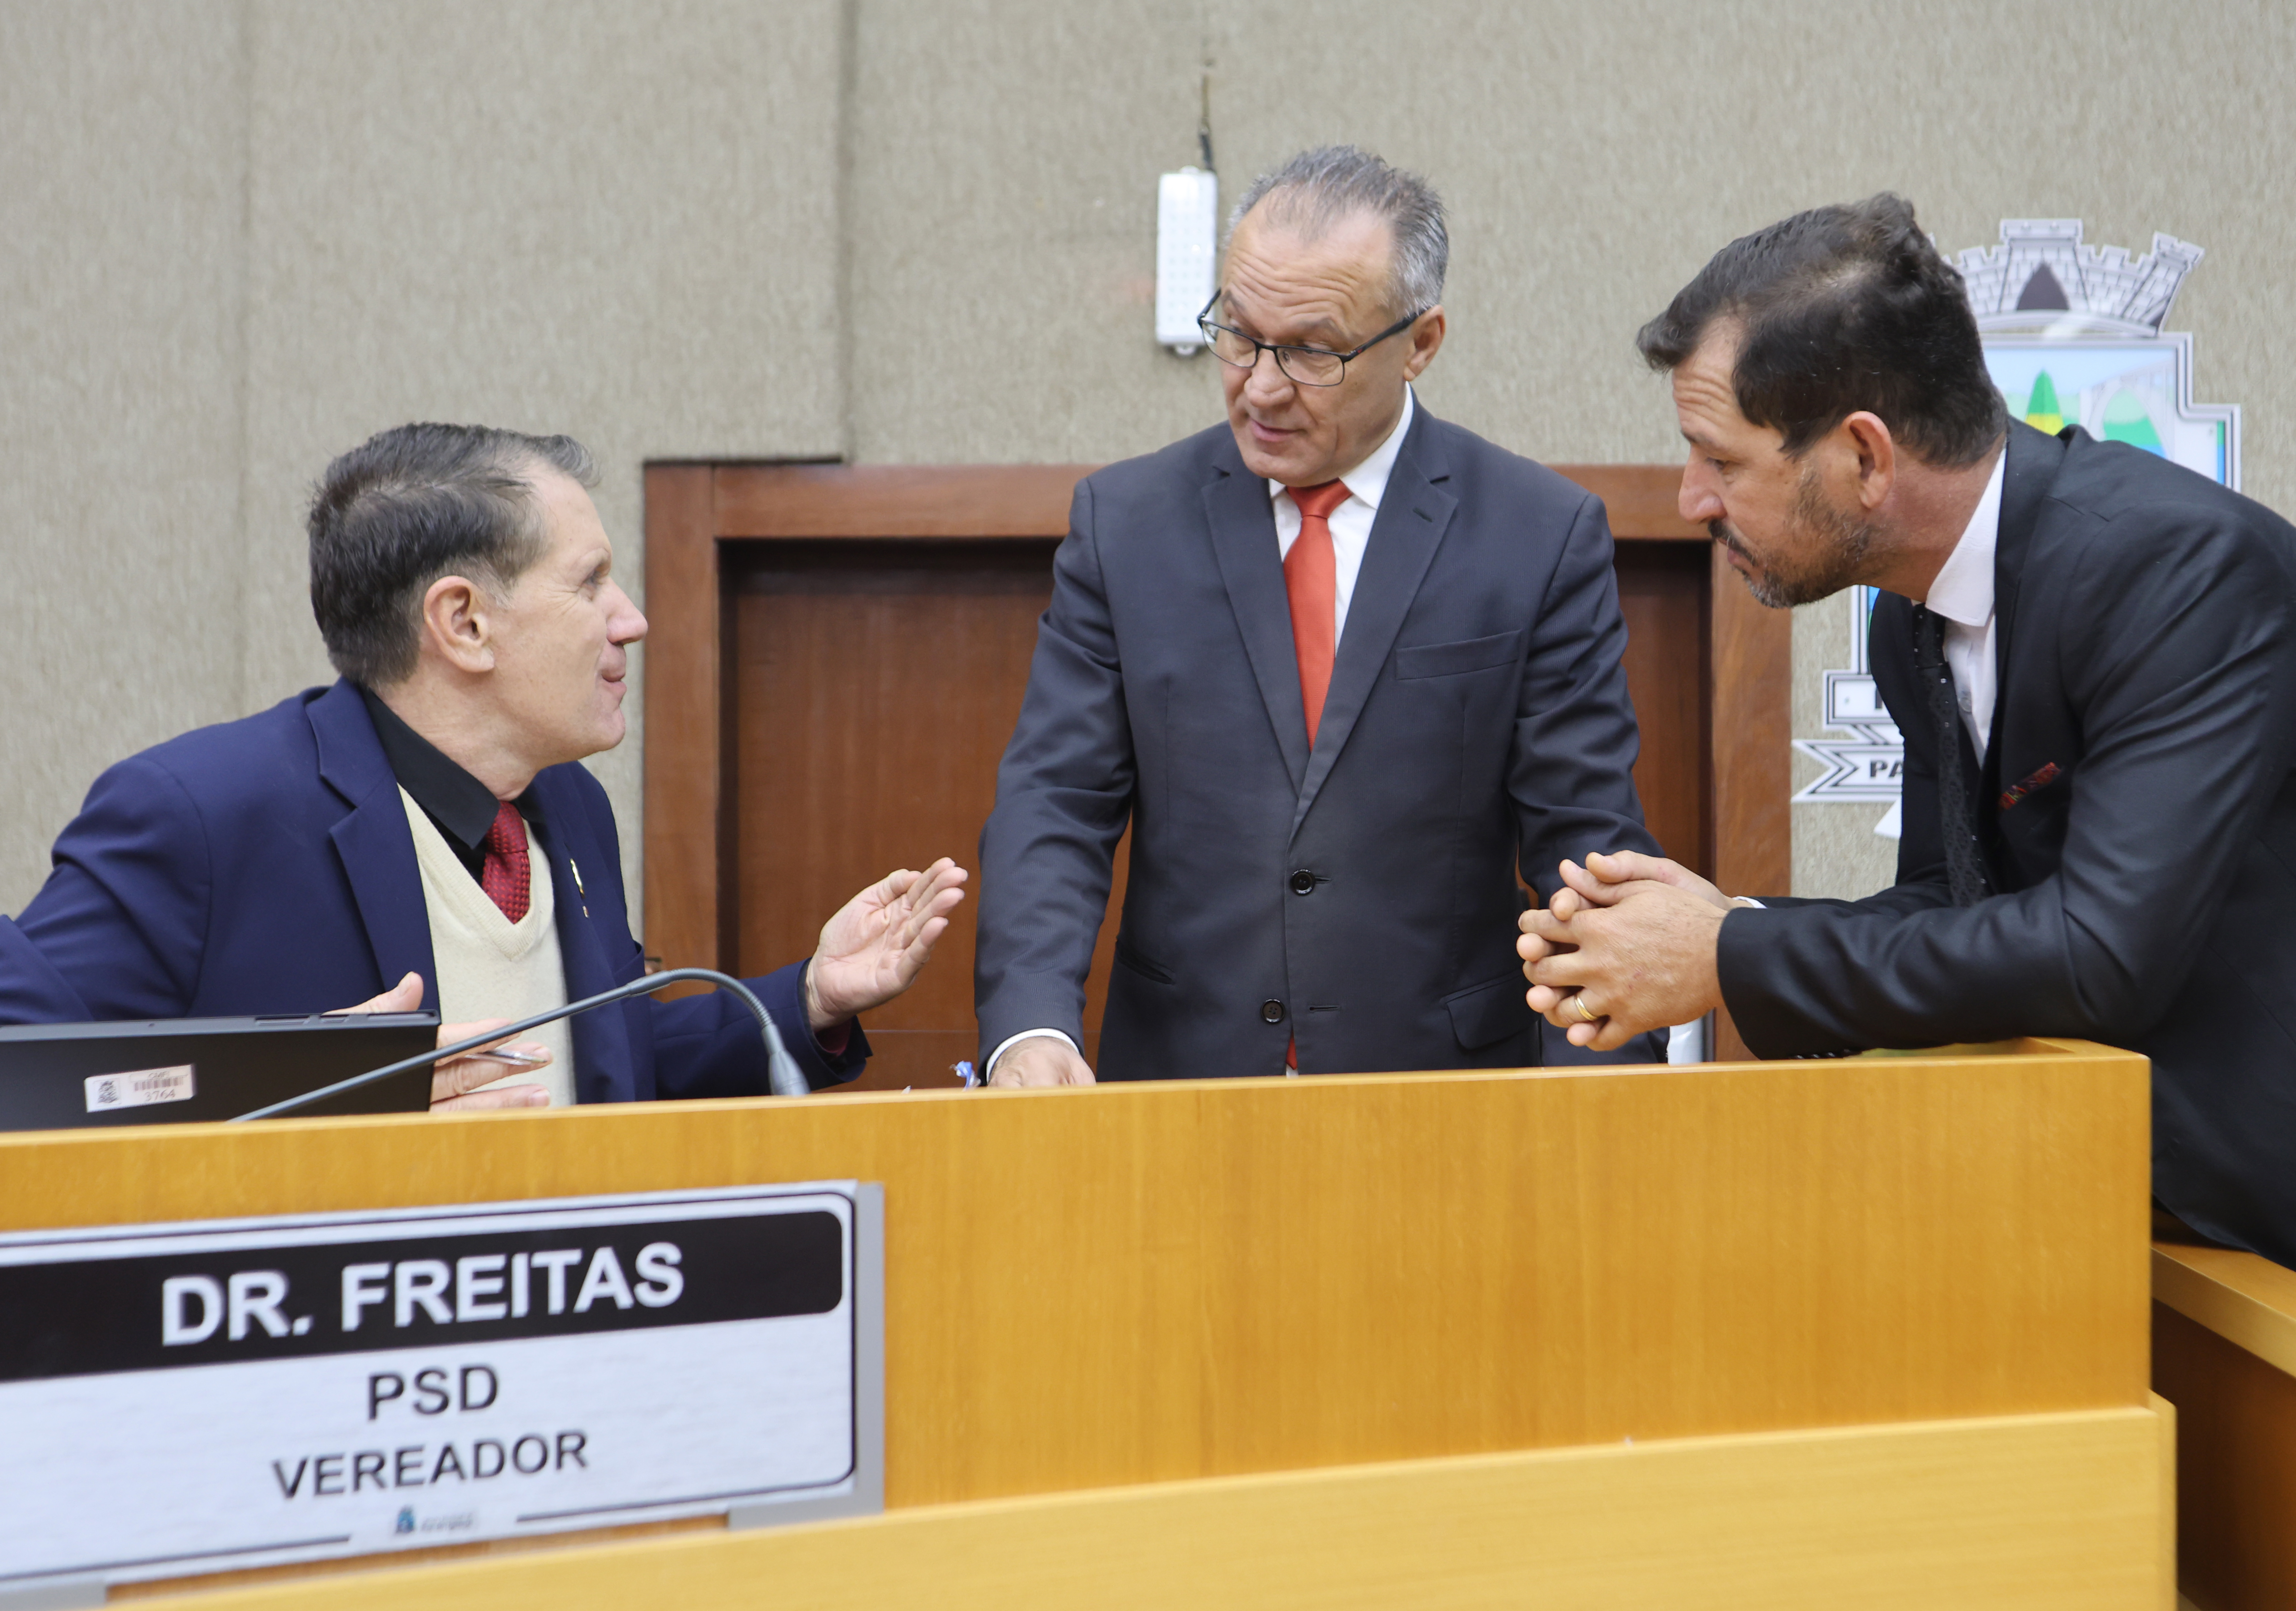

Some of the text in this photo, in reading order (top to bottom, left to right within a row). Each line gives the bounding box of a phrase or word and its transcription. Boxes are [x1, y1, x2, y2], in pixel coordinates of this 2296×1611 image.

[144, 1088, 176, 1101] 3764
[162, 1242, 684, 1345] DR. FREITAS
[368, 1365, 499, 1421] PSD
[272, 1431, 588, 1500] VEREADOR
